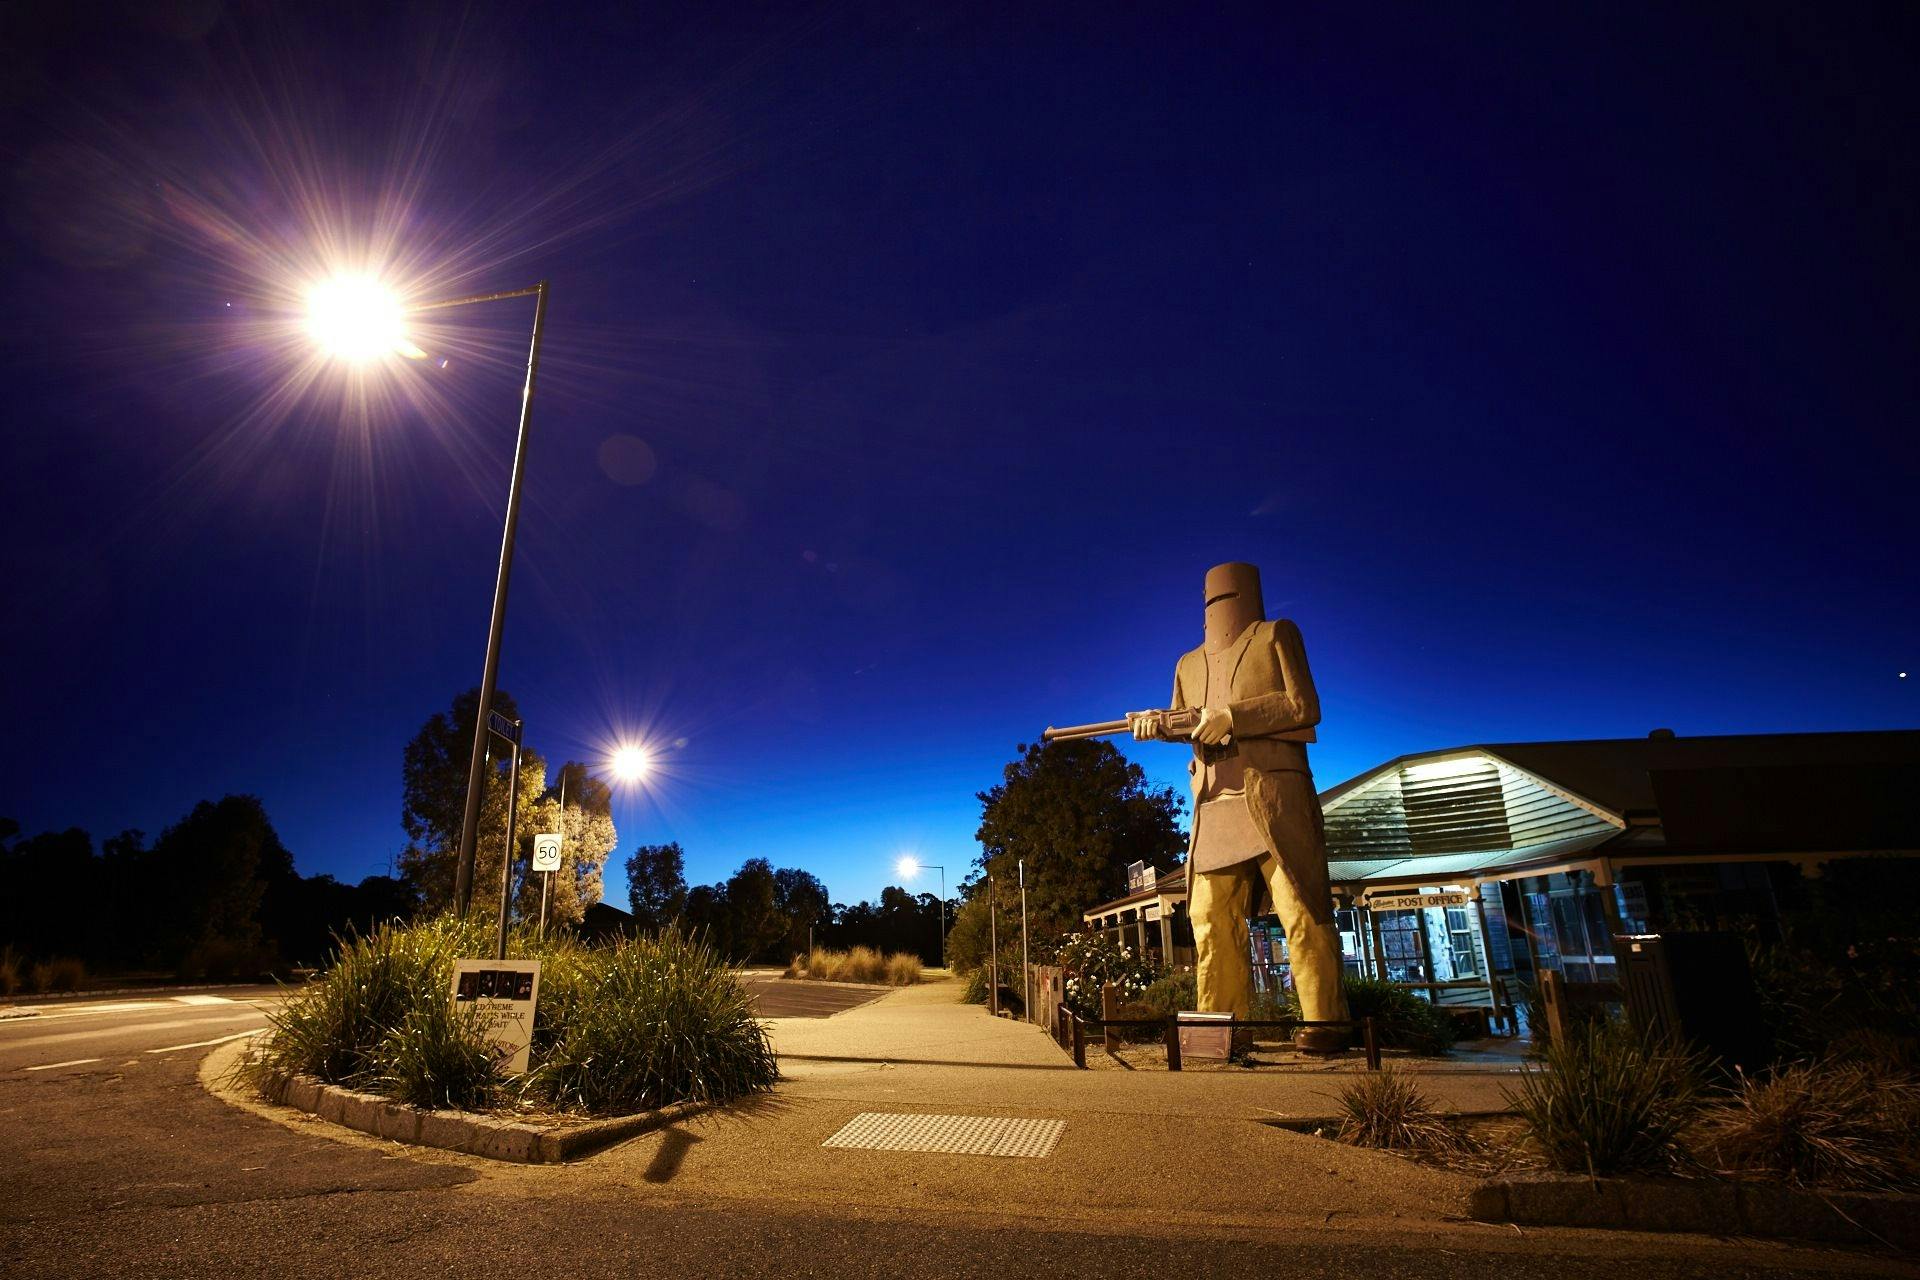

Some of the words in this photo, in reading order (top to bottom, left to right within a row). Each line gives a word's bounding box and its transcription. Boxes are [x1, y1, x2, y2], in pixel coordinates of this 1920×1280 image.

[538, 846, 557, 860] 50
[1397, 897, 1424, 907] POST
[1428, 894, 1463, 906] OFFICE
